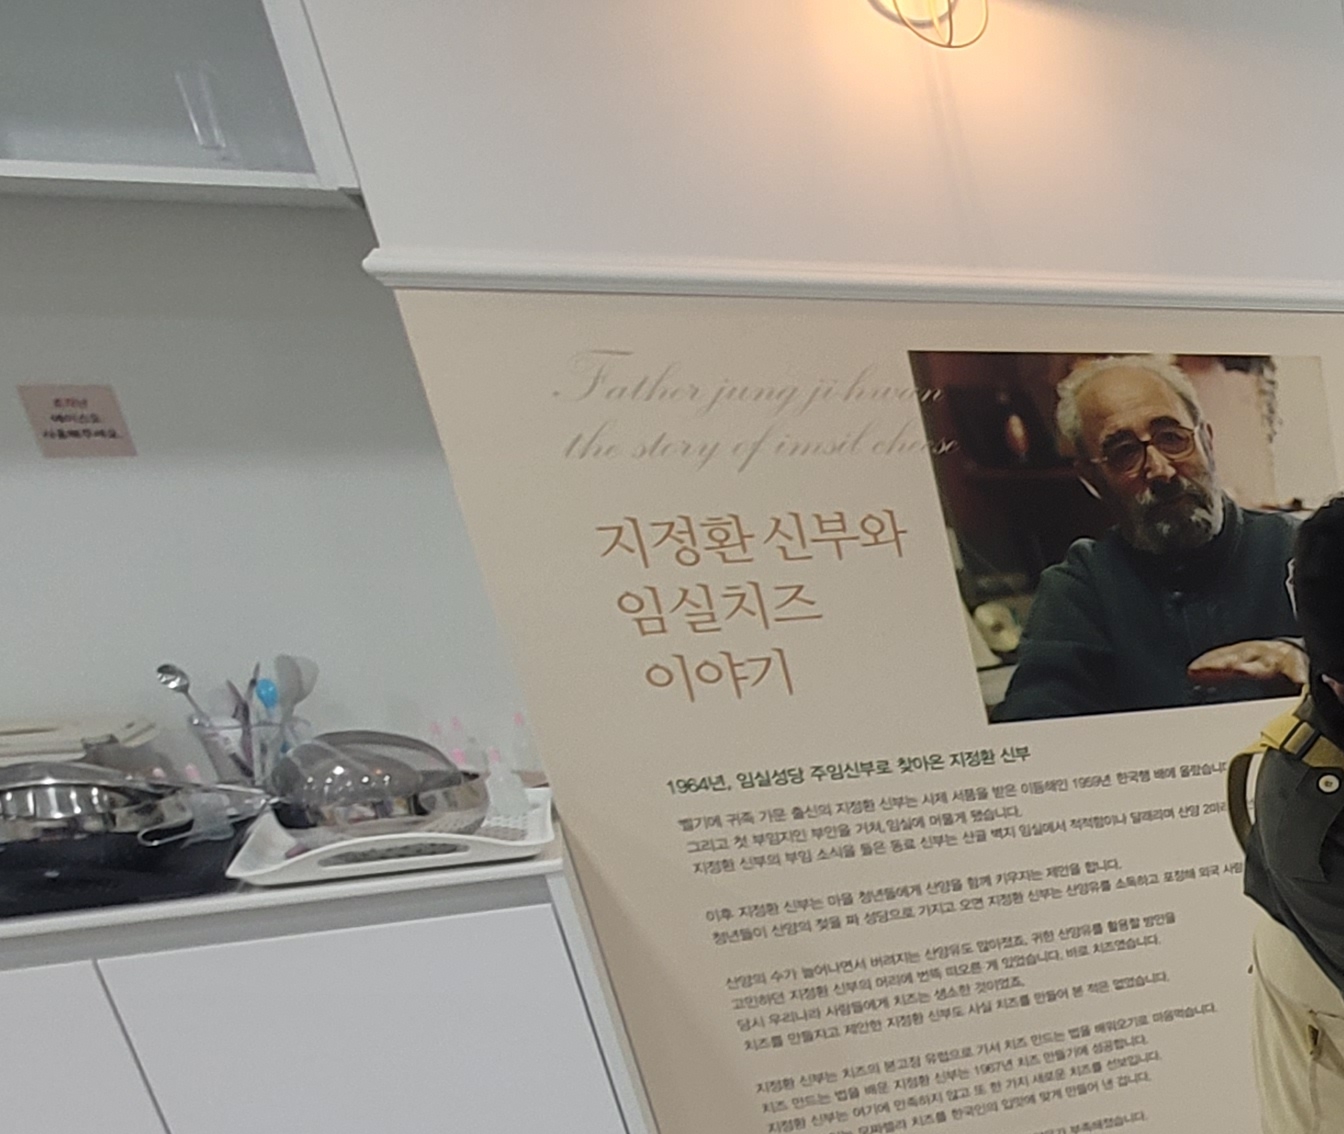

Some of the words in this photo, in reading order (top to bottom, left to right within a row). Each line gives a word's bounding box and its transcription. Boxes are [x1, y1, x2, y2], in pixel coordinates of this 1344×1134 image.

[553, 349, 700, 402] Father
[700, 378, 799, 418] jung
[564, 421, 617, 459] the
[632, 432, 720, 471] story
[732, 424, 776, 473] of
[775, 420, 868, 456] imsil
[871, 419, 959, 456] cheese
[596, 512, 755, 569] 지정환
[763, 508, 908, 561] 신부와
[617, 580, 823, 637] 임실치즈
[645, 647, 795, 703] 이야기
[666, 773, 732, 795] 1964년,
[735, 766, 805, 789] 임실성당
[809, 759, 893, 782] 주임신부로
[897, 753, 945, 774] 찾아온
[948, 748, 996, 768] 지정환
[1000, 745, 1031, 764] 신부
